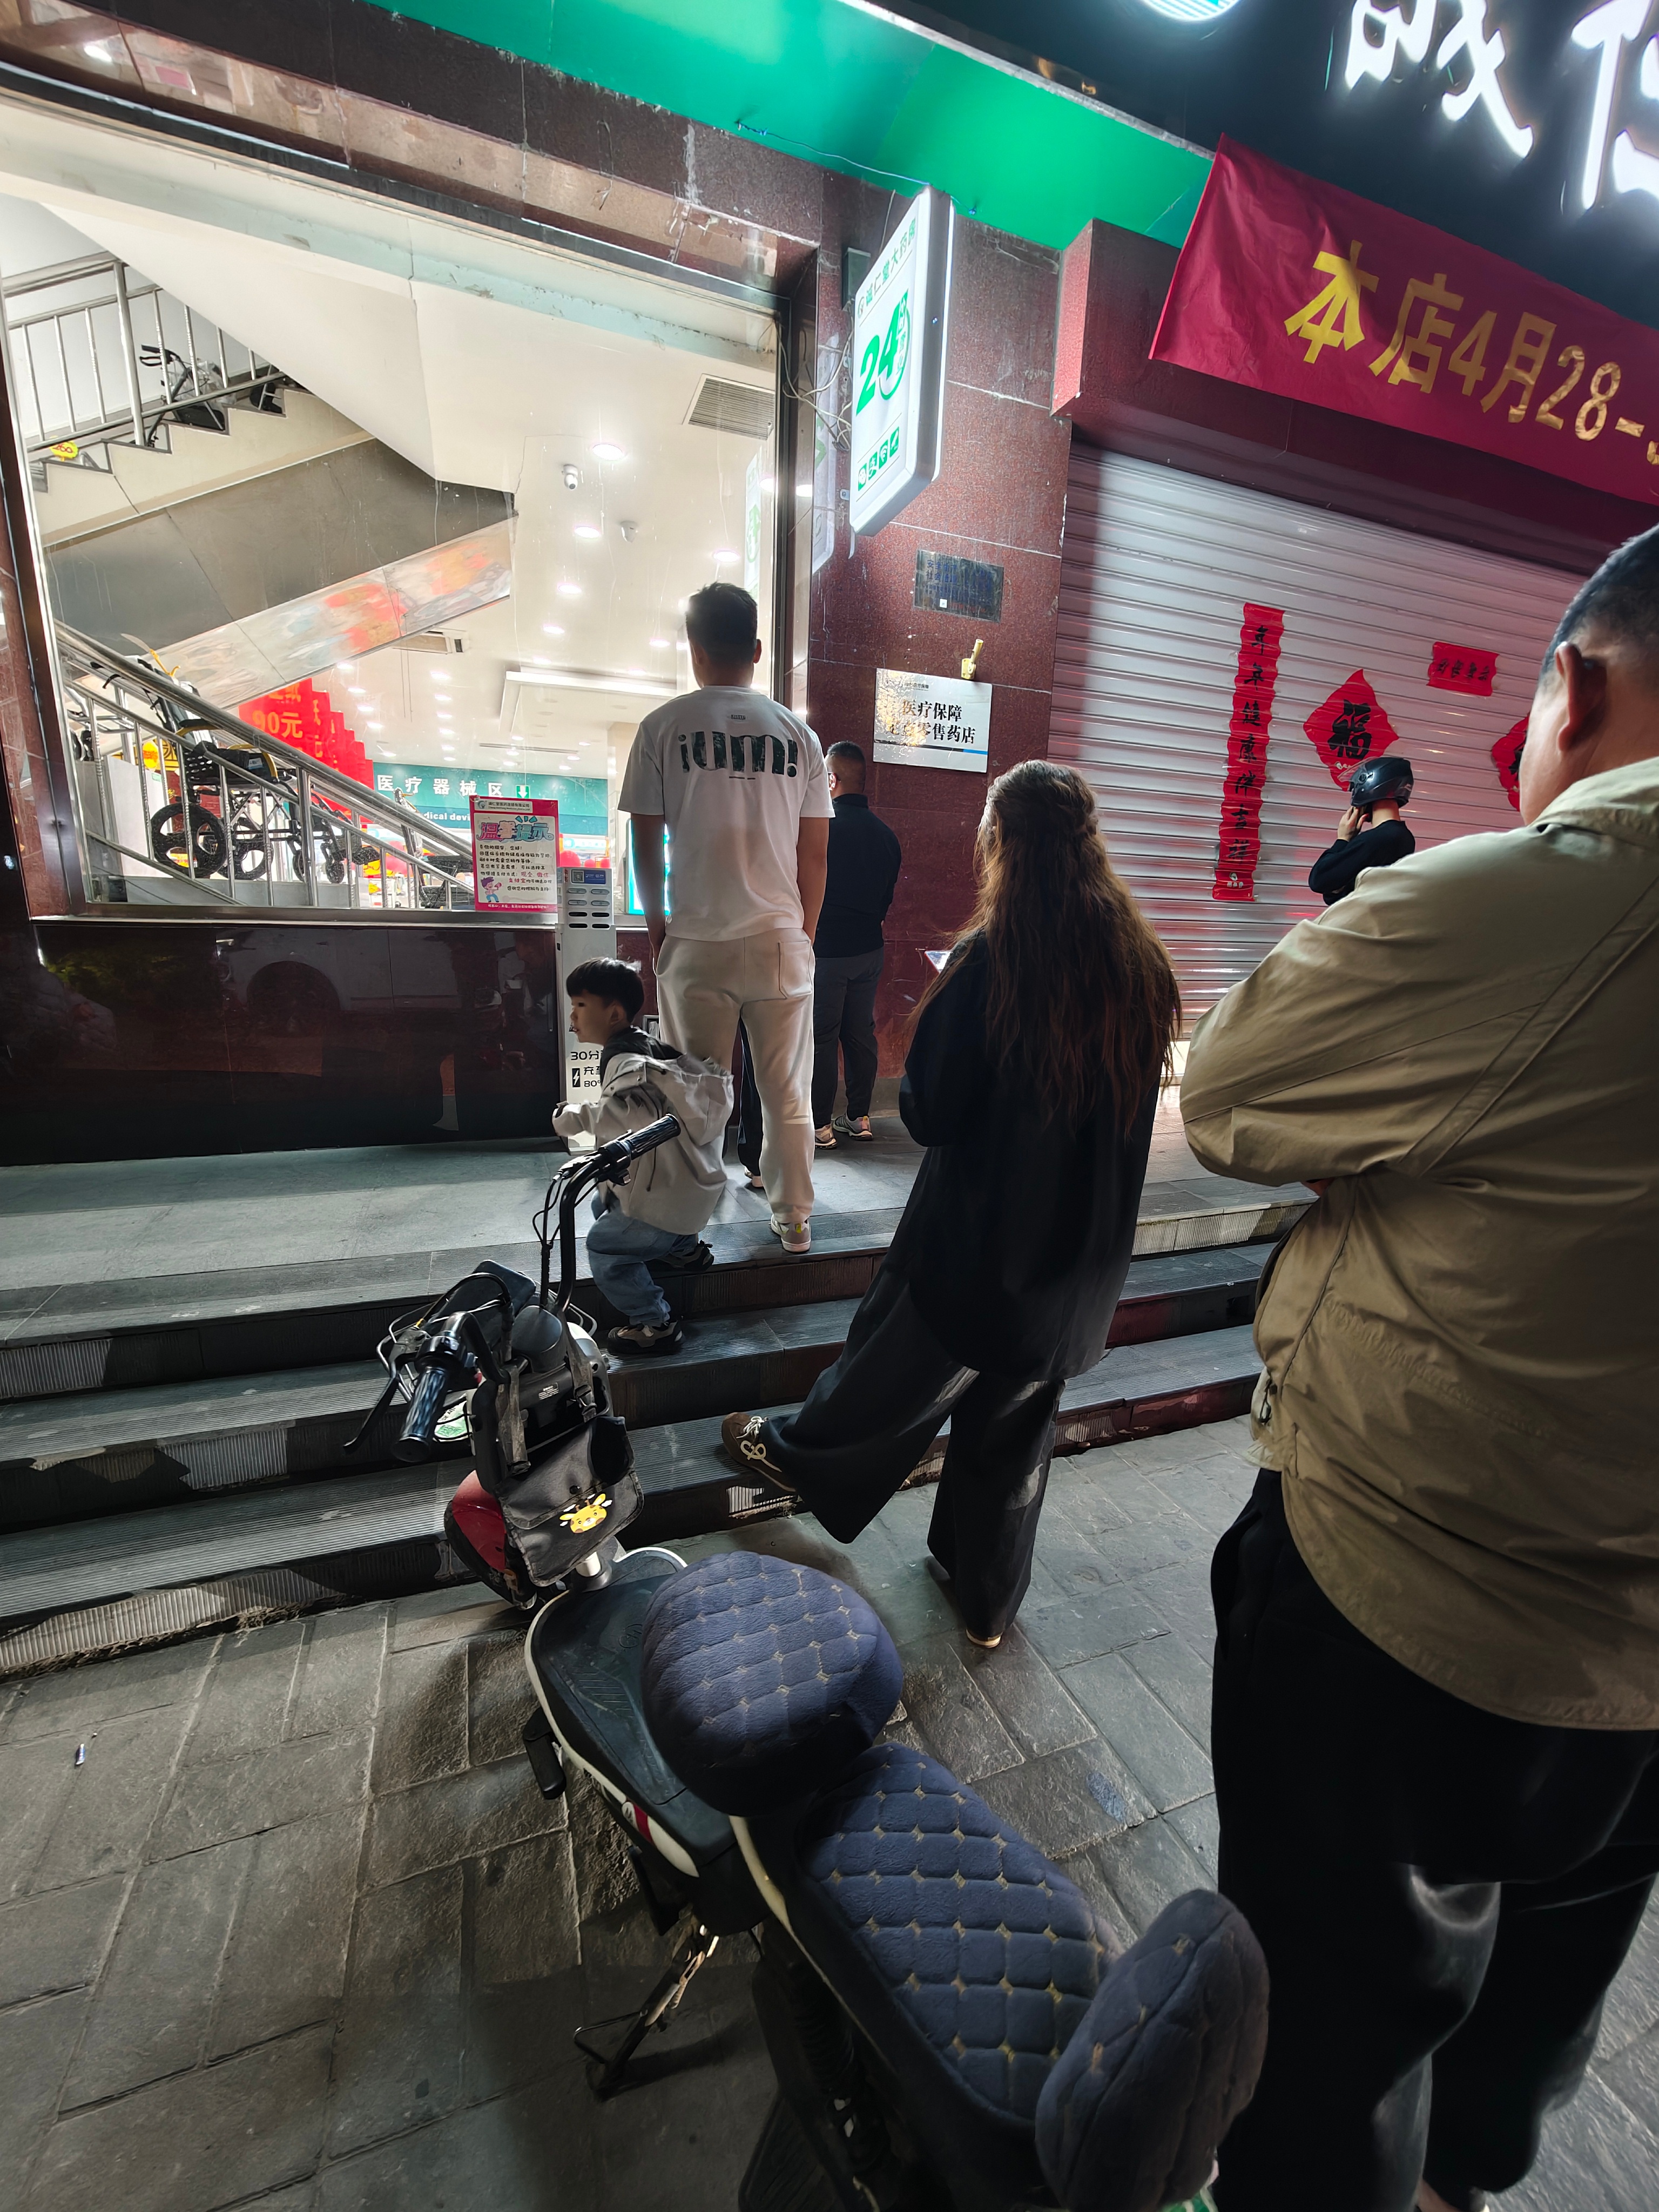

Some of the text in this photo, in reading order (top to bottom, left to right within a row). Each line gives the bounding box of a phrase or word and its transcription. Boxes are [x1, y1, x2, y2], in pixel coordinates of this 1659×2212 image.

[866, 217, 916, 307] 诚仁堂大药房
[855, 287, 909, 417] 24
[902, 699, 962, 722] 医疗保障
[252, 710, 303, 738] 90元
[1327, 699, 1373, 760] 福
[377, 774, 503, 798] 医疗器械区
[423, 811, 470, 821] dical devi
[476, 820, 555, 842] 温馨提示
[570, 1050, 603, 1061] 30分
